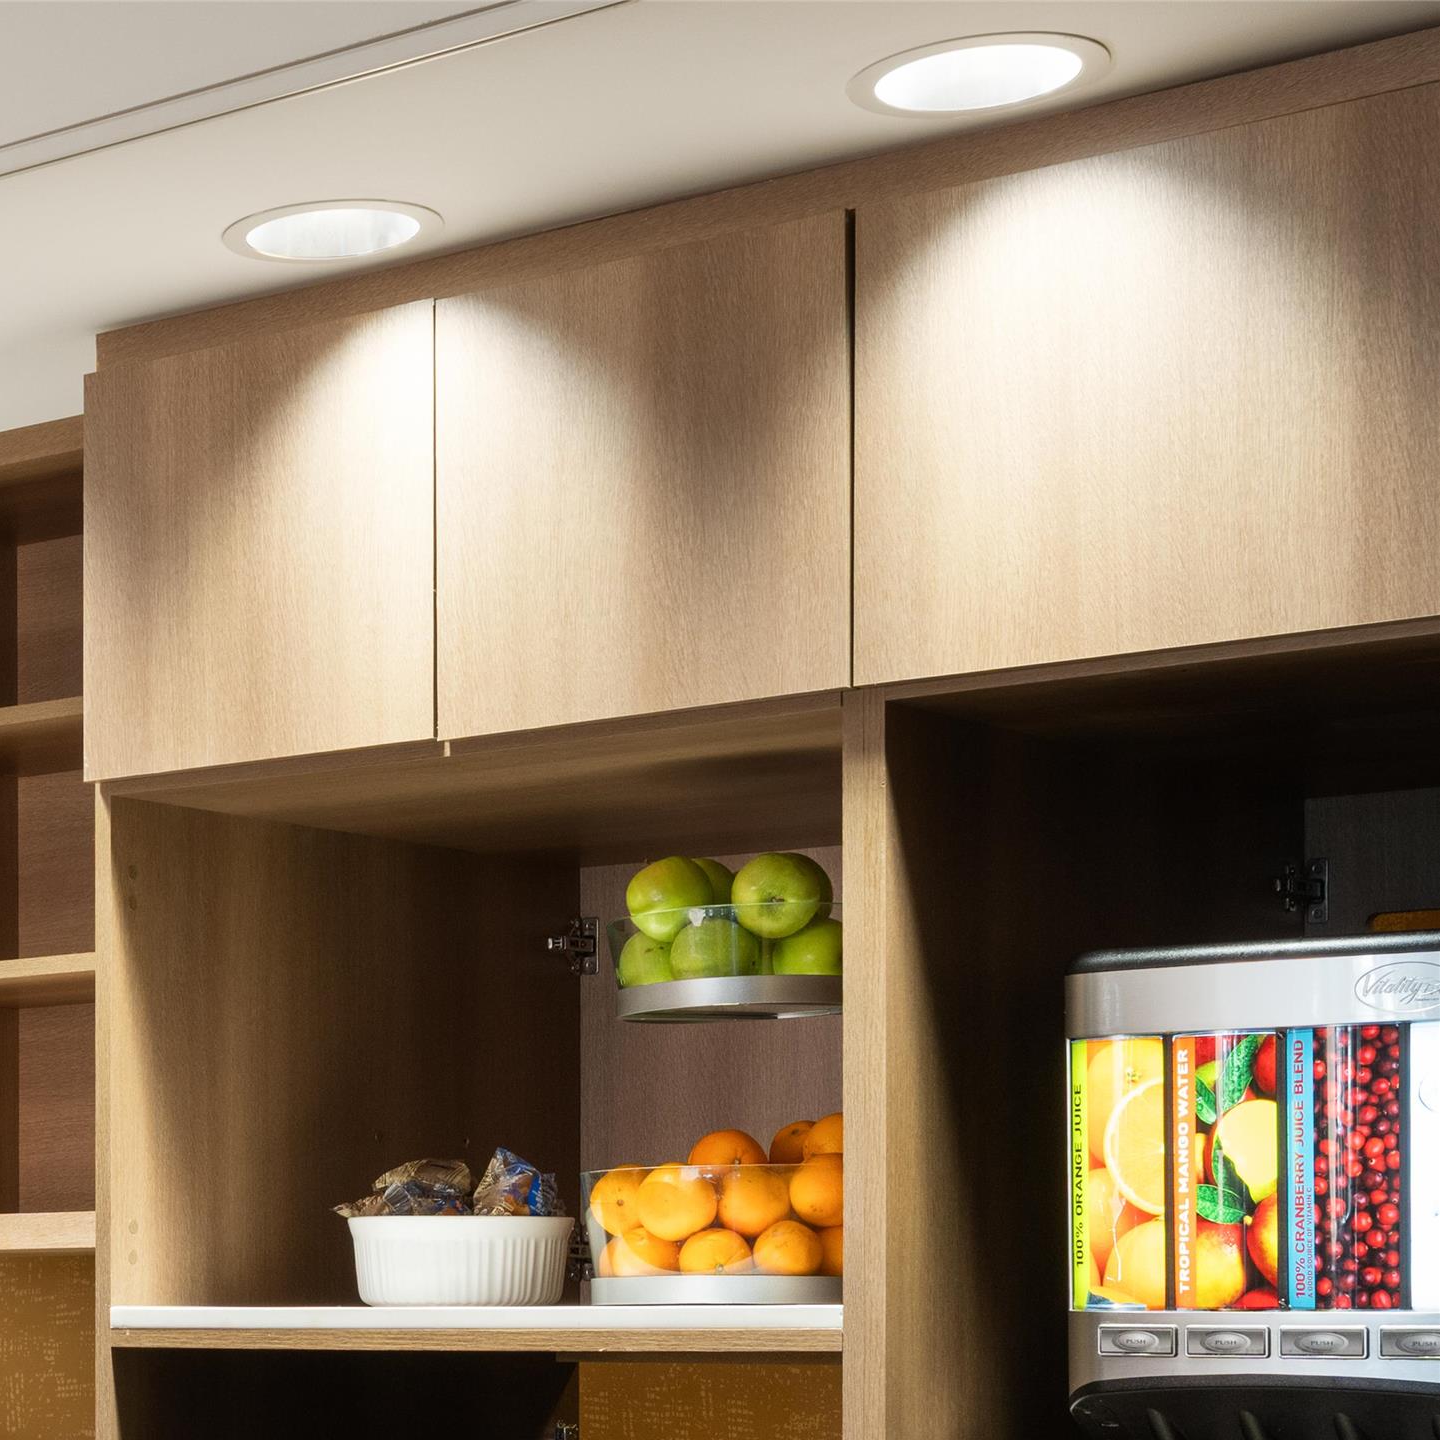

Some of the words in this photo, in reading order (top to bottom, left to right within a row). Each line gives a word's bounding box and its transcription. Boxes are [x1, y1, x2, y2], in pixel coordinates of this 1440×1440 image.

[1362, 970, 1423, 1005] Vitality
[1177, 1049, 1188, 1118] WATER
[1293, 1039, 1304, 1095] BLEND
[1074, 1084, 1082, 1133] JUICE
[1294, 1100, 1304, 1147] JUICE
[1074, 1143, 1083, 1216] ORANGE
[1178, 1122, 1189, 1192] MANGO
[1294, 1152, 1306, 1253] CRANBERRY
[1076, 1221, 1084, 1265] 100%
[1179, 1198, 1189, 1294] TROPICAL
[1295, 1258, 1306, 1298] 100%
[1310, 1339, 1334, 1347] PUSH
[1412, 1340, 1439, 1348] PUSH
